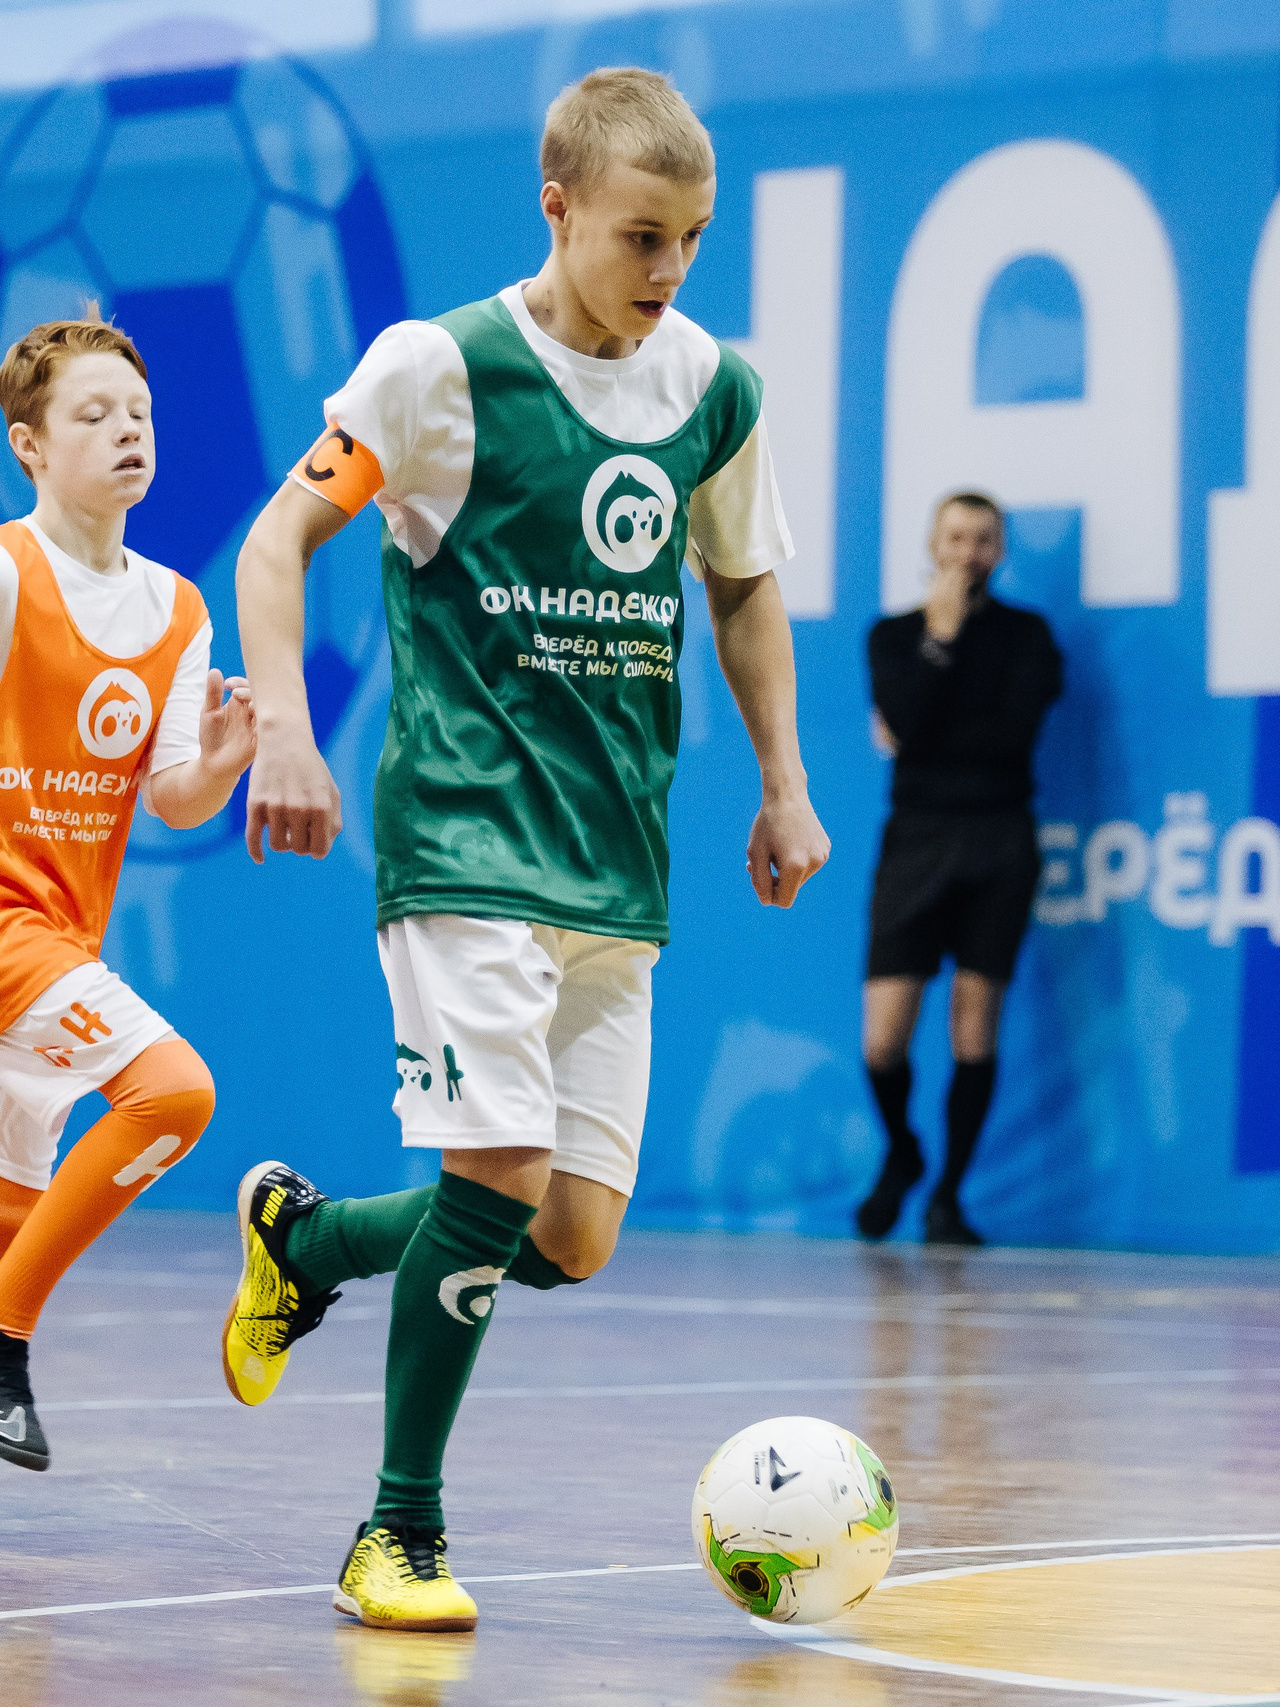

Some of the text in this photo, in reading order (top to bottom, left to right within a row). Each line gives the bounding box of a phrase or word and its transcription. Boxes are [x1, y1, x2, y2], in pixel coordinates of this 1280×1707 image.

[480, 586, 535, 614] ФК
[618, 640, 673, 664] ПОБЕД
[586, 660, 618, 676] МЫ
[84, 813, 97, 825] К
[70, 829, 96, 843] МЫ
